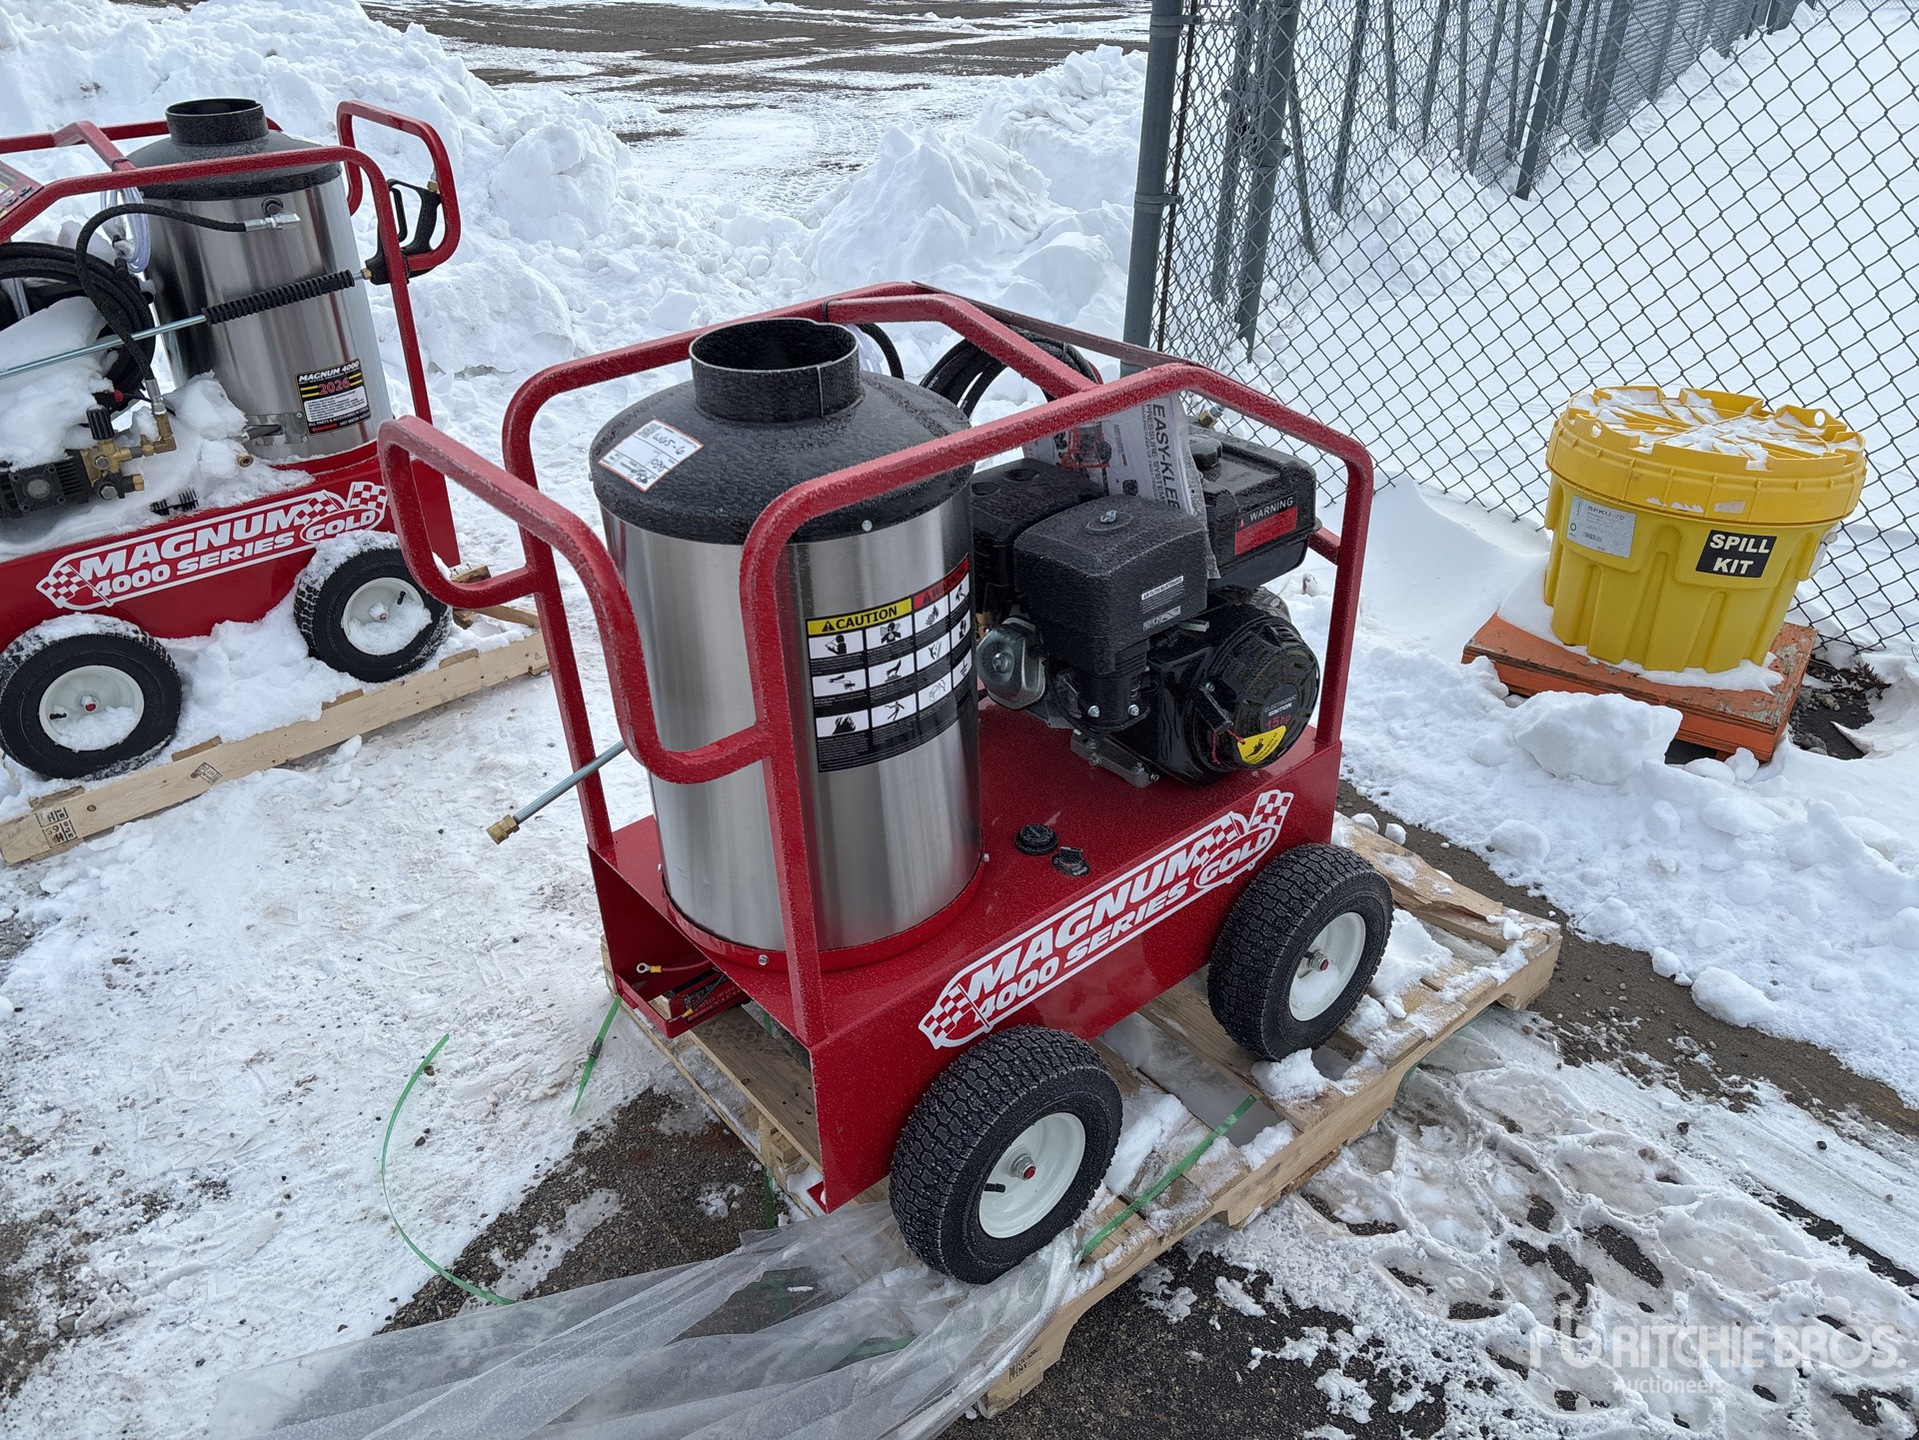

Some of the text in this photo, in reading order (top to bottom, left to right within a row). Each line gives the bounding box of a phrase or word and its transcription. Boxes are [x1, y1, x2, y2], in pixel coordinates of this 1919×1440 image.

[299, 367, 341, 382] MAGNUM
[342, 361, 360, 373] 4000
[318, 377, 350, 396] 2026
[1145, 404, 1158, 459] PRESSURE
[1152, 403, 1181, 511] EASY-KLEE
[1249, 496, 1294, 522] WARNING
[305, 509, 377, 541] GOLD
[79, 502, 308, 581] MAGNUM
[1709, 533, 1770, 554] SPILL
[92, 531, 295, 598] 4000 SERIES
[1712, 557, 1754, 575] KIT
[836, 605, 898, 630] CAUTION
[1264, 694, 1297, 712] ELECTRONIC
[1268, 703, 1293, 717] IGNITION
[1199, 827, 1273, 885] GOLD
[967, 835, 1214, 1000] MAGNUM
[974, 877, 1190, 1022] 4000 SERIES
